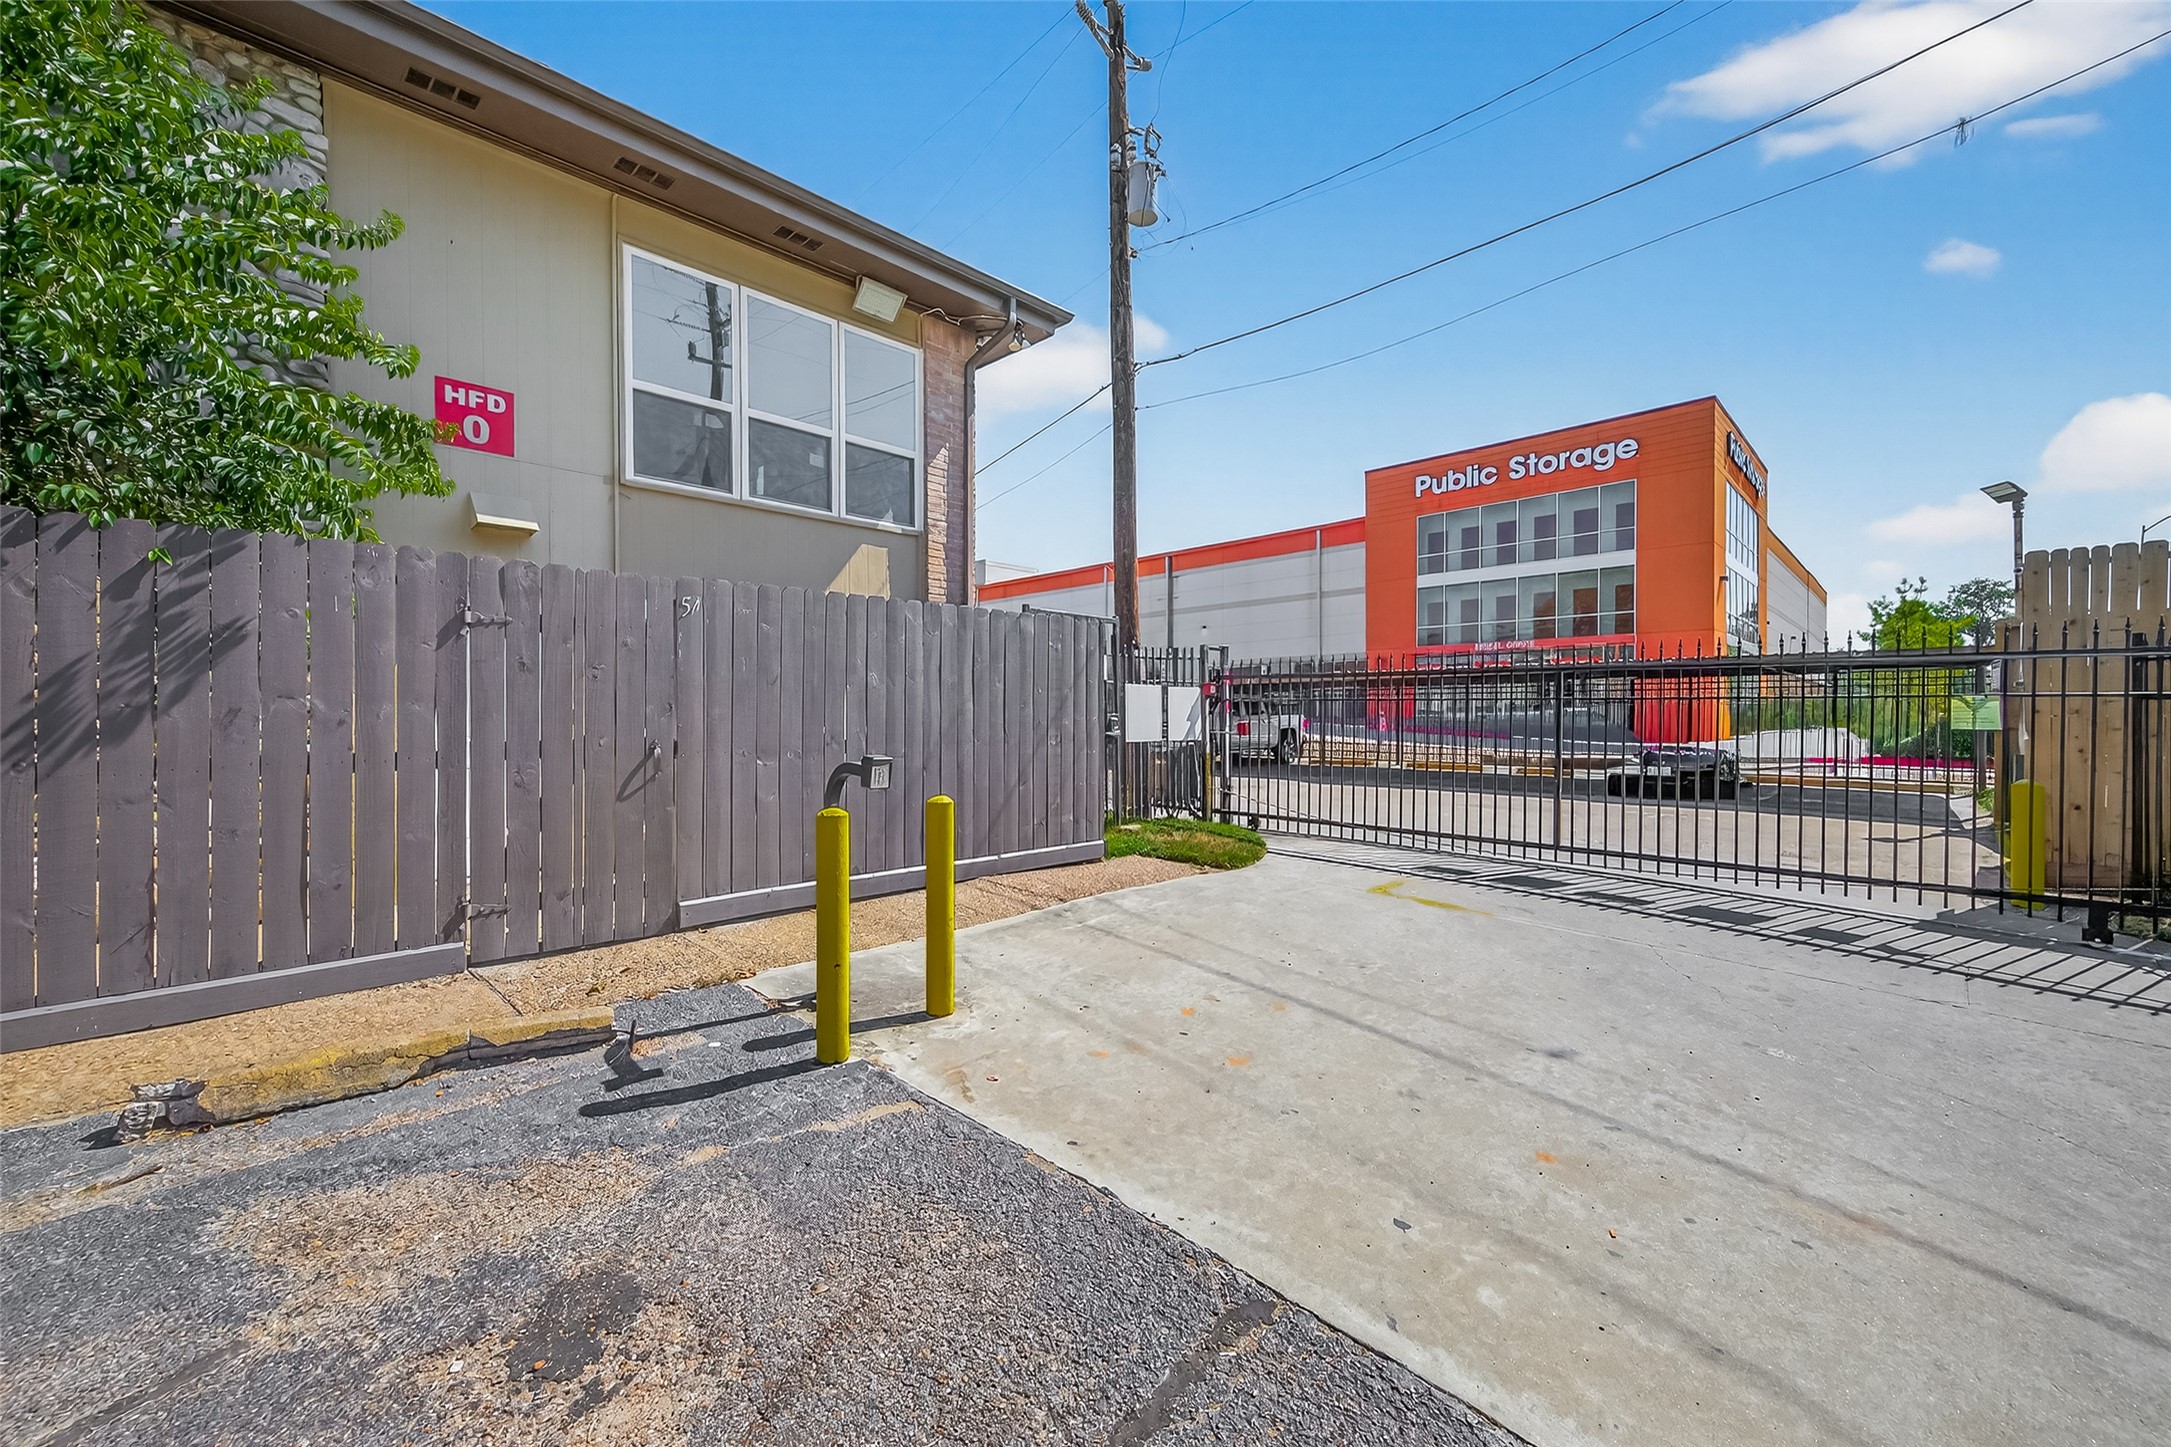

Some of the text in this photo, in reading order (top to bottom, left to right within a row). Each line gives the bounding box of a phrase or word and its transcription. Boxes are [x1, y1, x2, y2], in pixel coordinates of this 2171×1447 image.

[444, 384, 507, 414] HFD
[462, 414, 490, 445] 0
[1414, 437, 1639, 498] Public Storage
